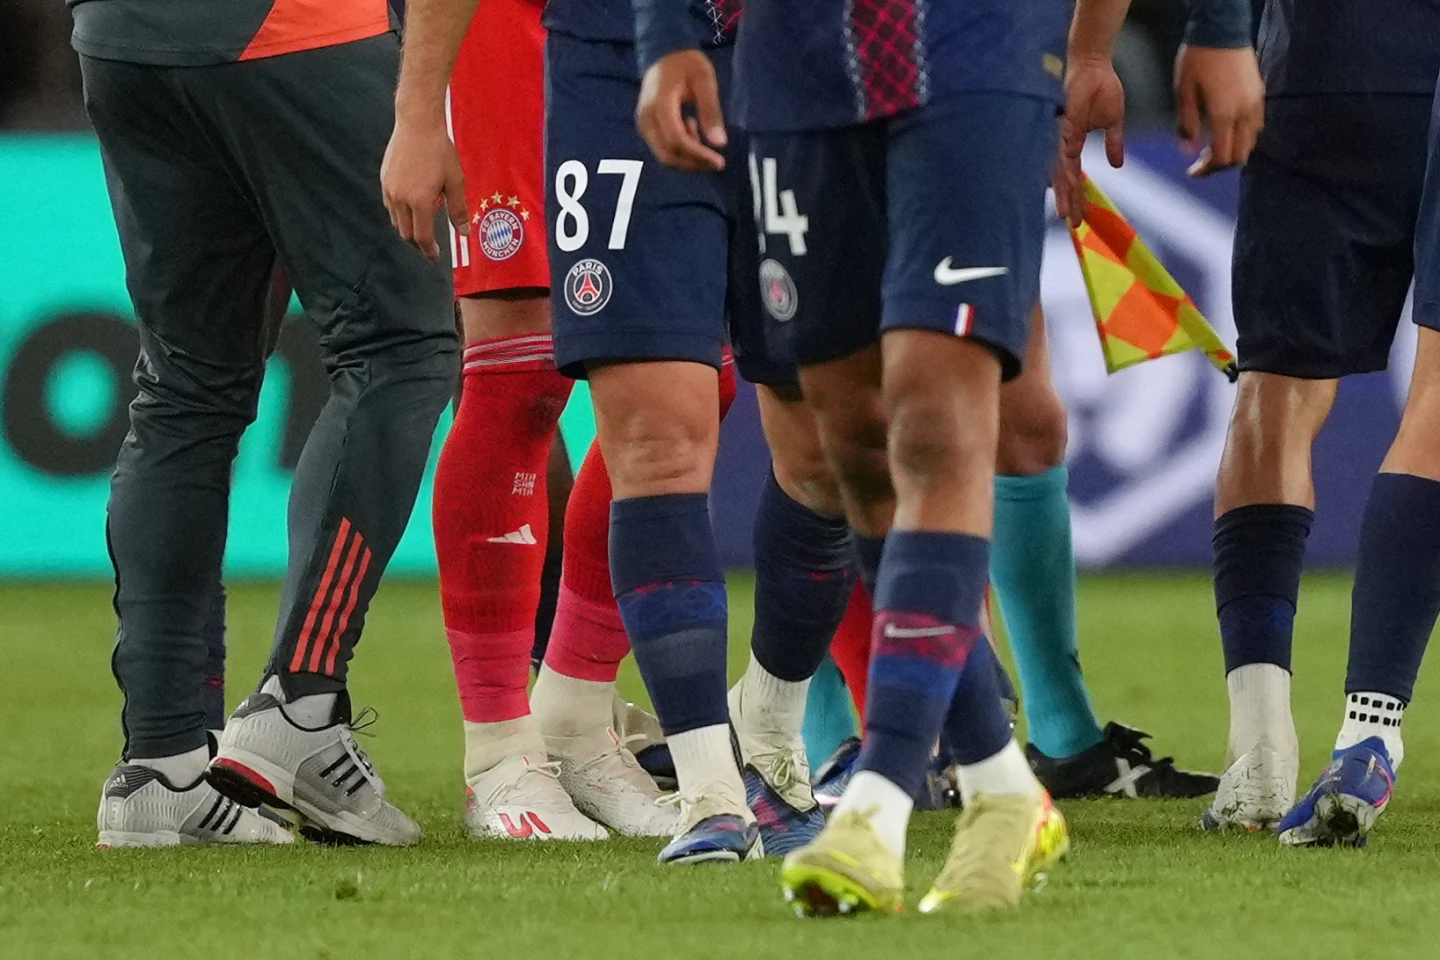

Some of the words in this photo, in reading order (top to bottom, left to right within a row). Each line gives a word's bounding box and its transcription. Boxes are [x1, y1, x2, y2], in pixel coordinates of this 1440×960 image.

[555, 159, 644, 252] 87
[489, 212, 519, 231] BAYERN
[573, 261, 604, 277] PARIS
